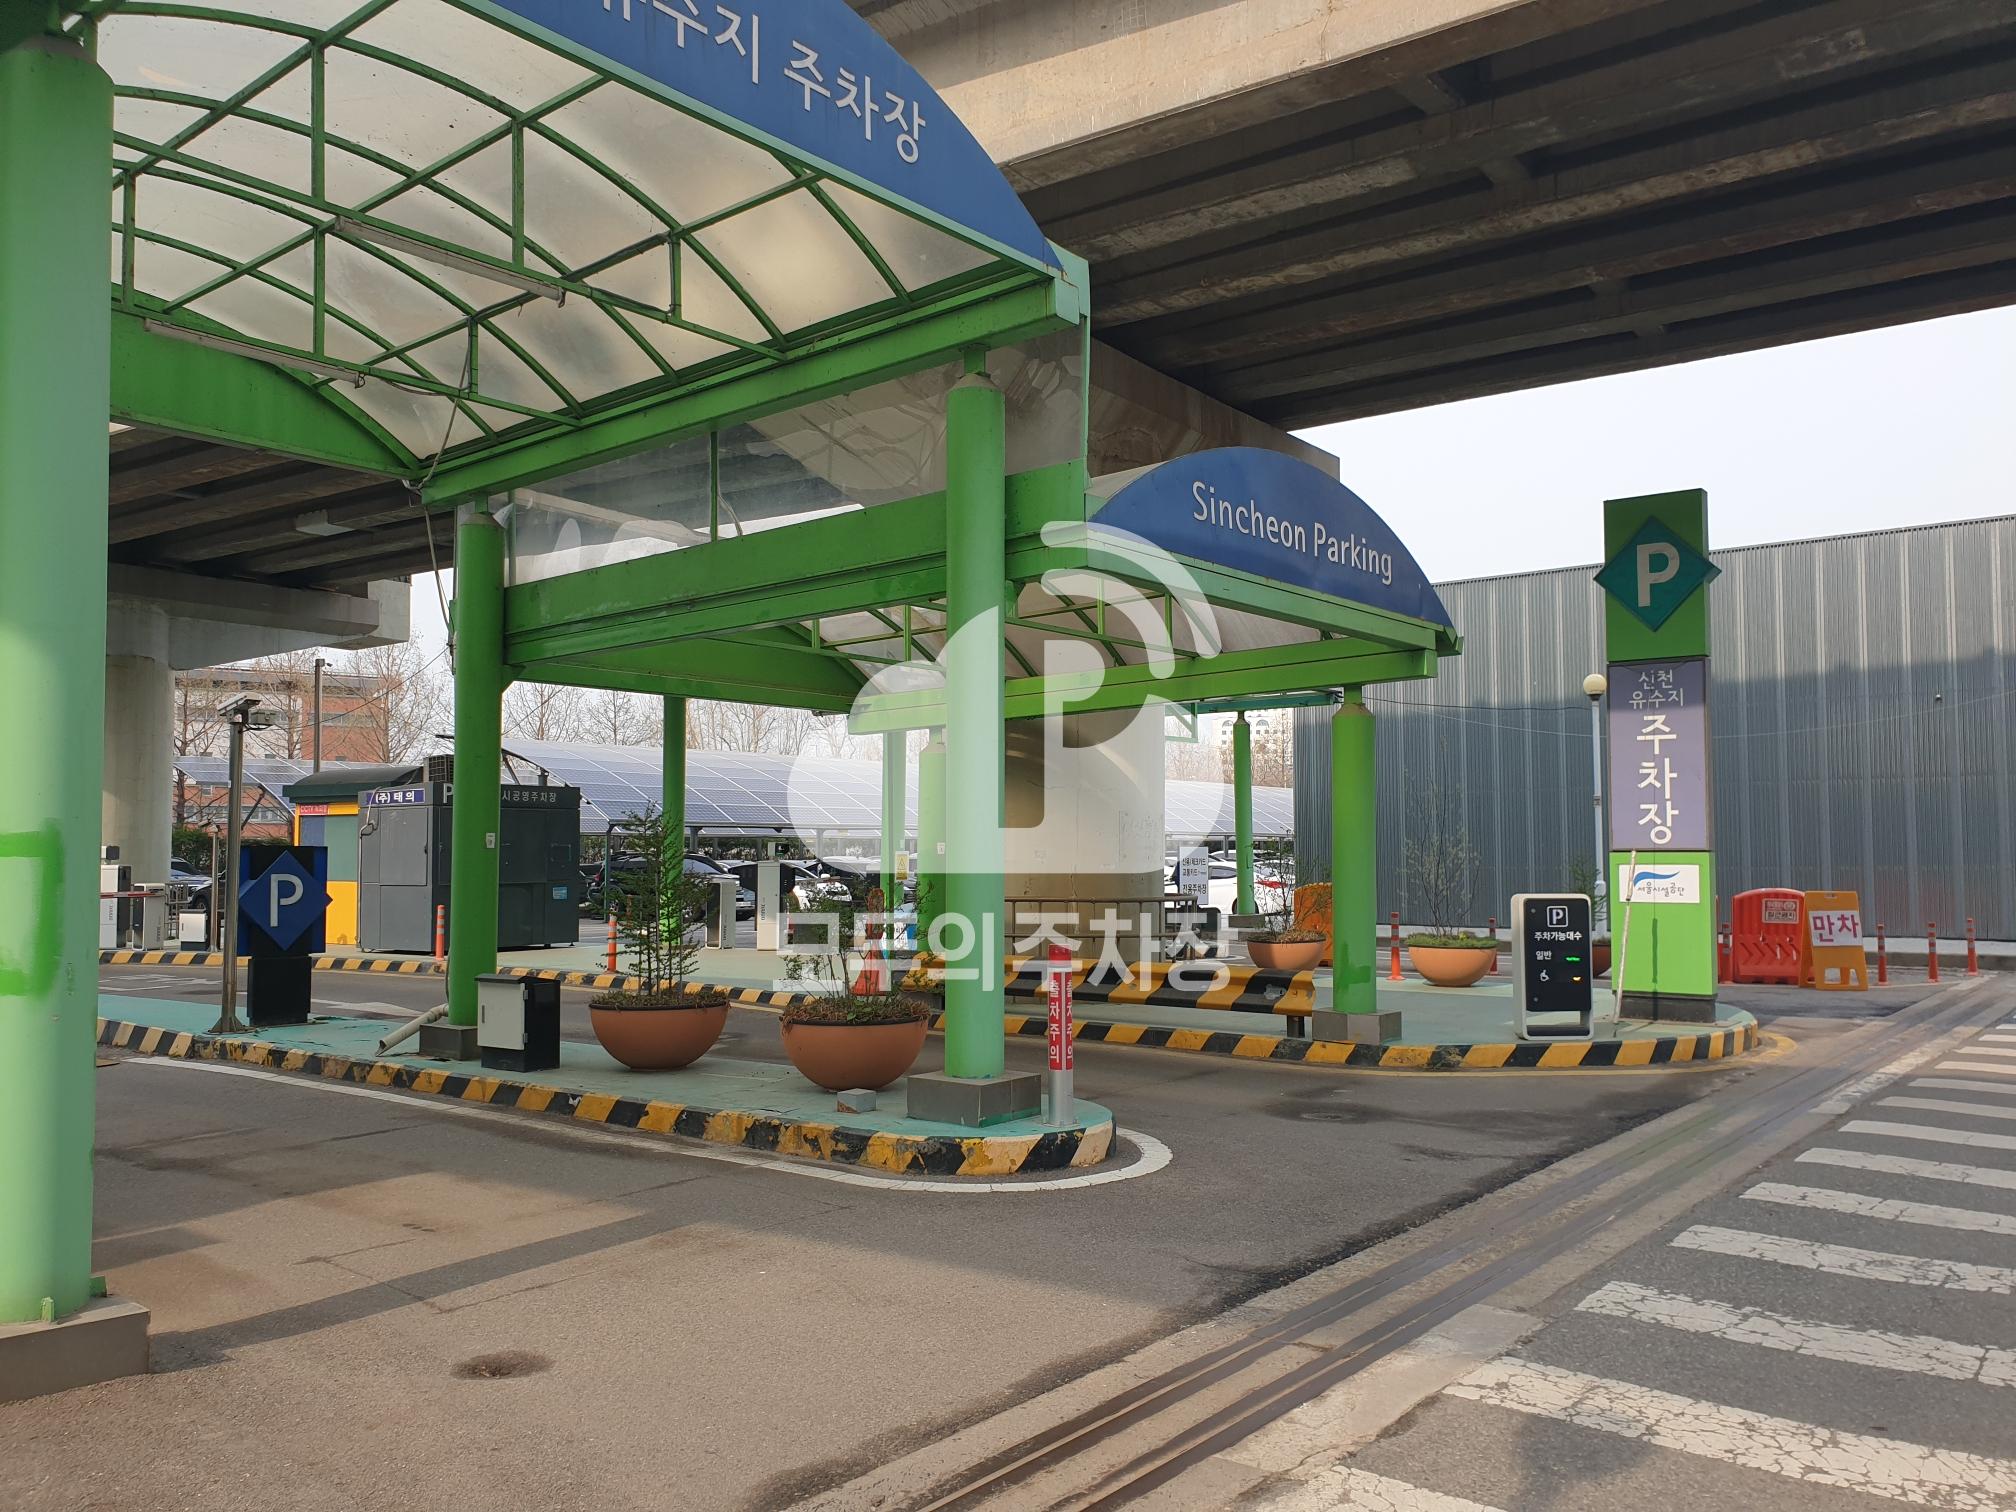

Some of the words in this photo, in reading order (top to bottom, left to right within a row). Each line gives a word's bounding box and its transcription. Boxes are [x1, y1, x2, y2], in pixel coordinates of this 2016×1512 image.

[603, 0, 758, 84] 수지
[784, 40, 926, 163] 주차장
[1192, 481, 1306, 553] Sincheon
[1314, 522, 1392, 586] Parking
[1636, 542, 1680, 608] P
[1639, 669, 1674, 691] 신천
[1628, 688, 1685, 710] 유수지
[1636, 714, 1680, 846] 주차장
[375, 793, 390, 804] (주)
[270, 873, 304, 928] P
[1552, 908, 1564, 925] P
[1812, 914, 1859, 942] 만차
[1534, 931, 1582, 941] 주차가능대수
[1535, 950, 1552, 961] 일반
